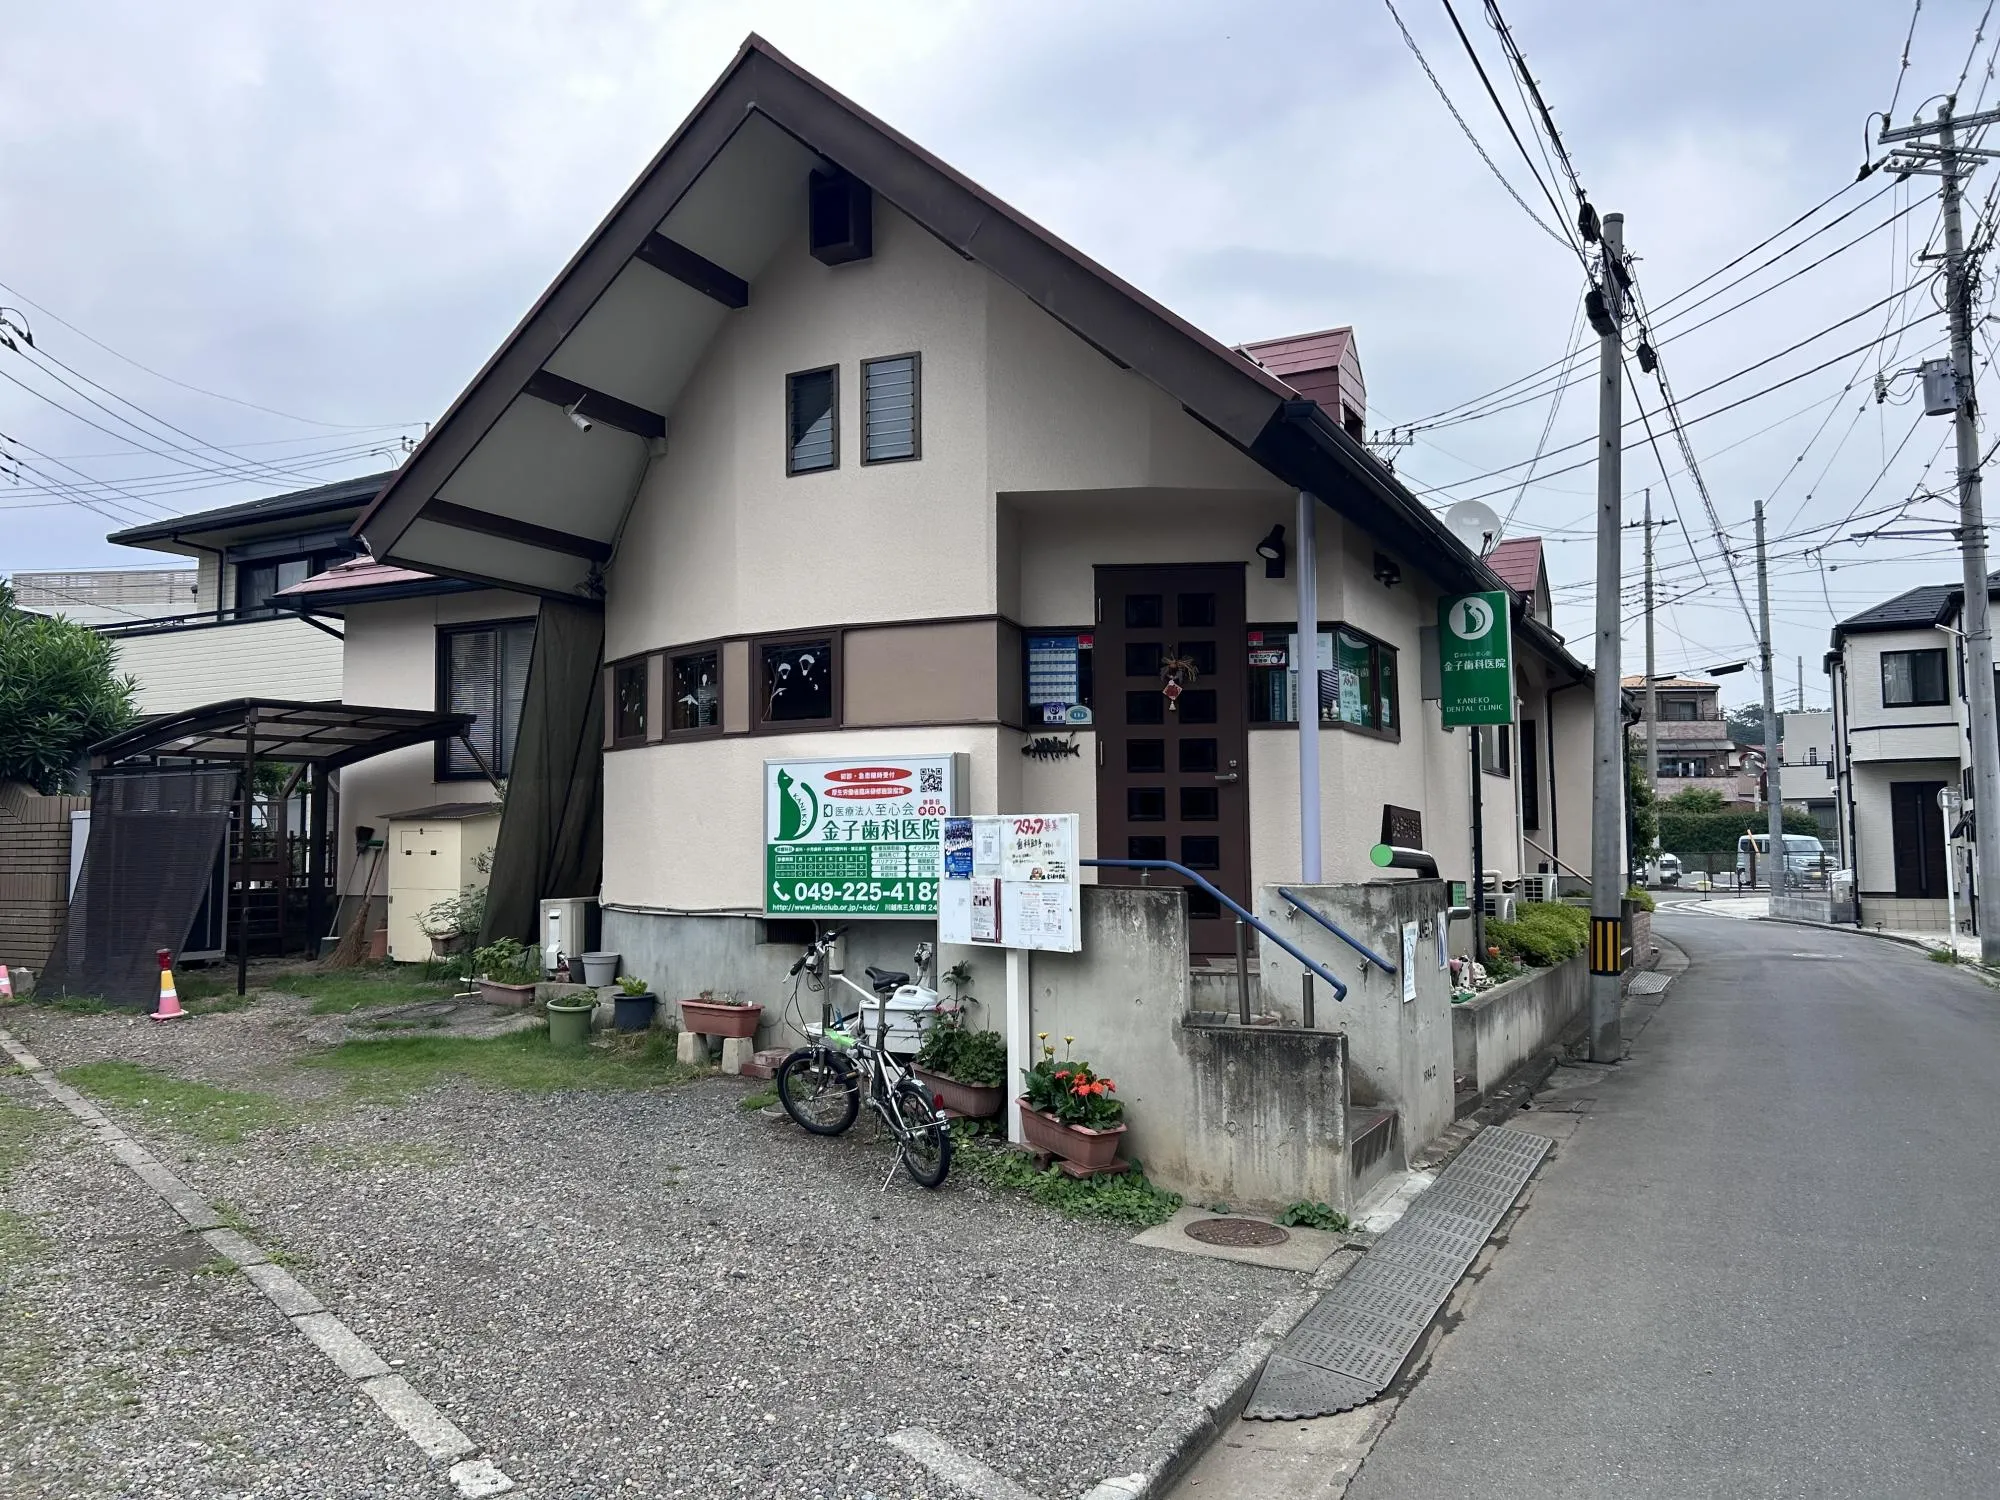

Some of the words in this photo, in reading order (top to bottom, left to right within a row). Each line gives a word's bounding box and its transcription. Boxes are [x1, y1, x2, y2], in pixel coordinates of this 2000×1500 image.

[1444, 658, 1506, 672] 金子歯科医院
[835, 802, 914, 816] 医療法人至心会
[822, 820, 940, 841] 金子歯科医院
